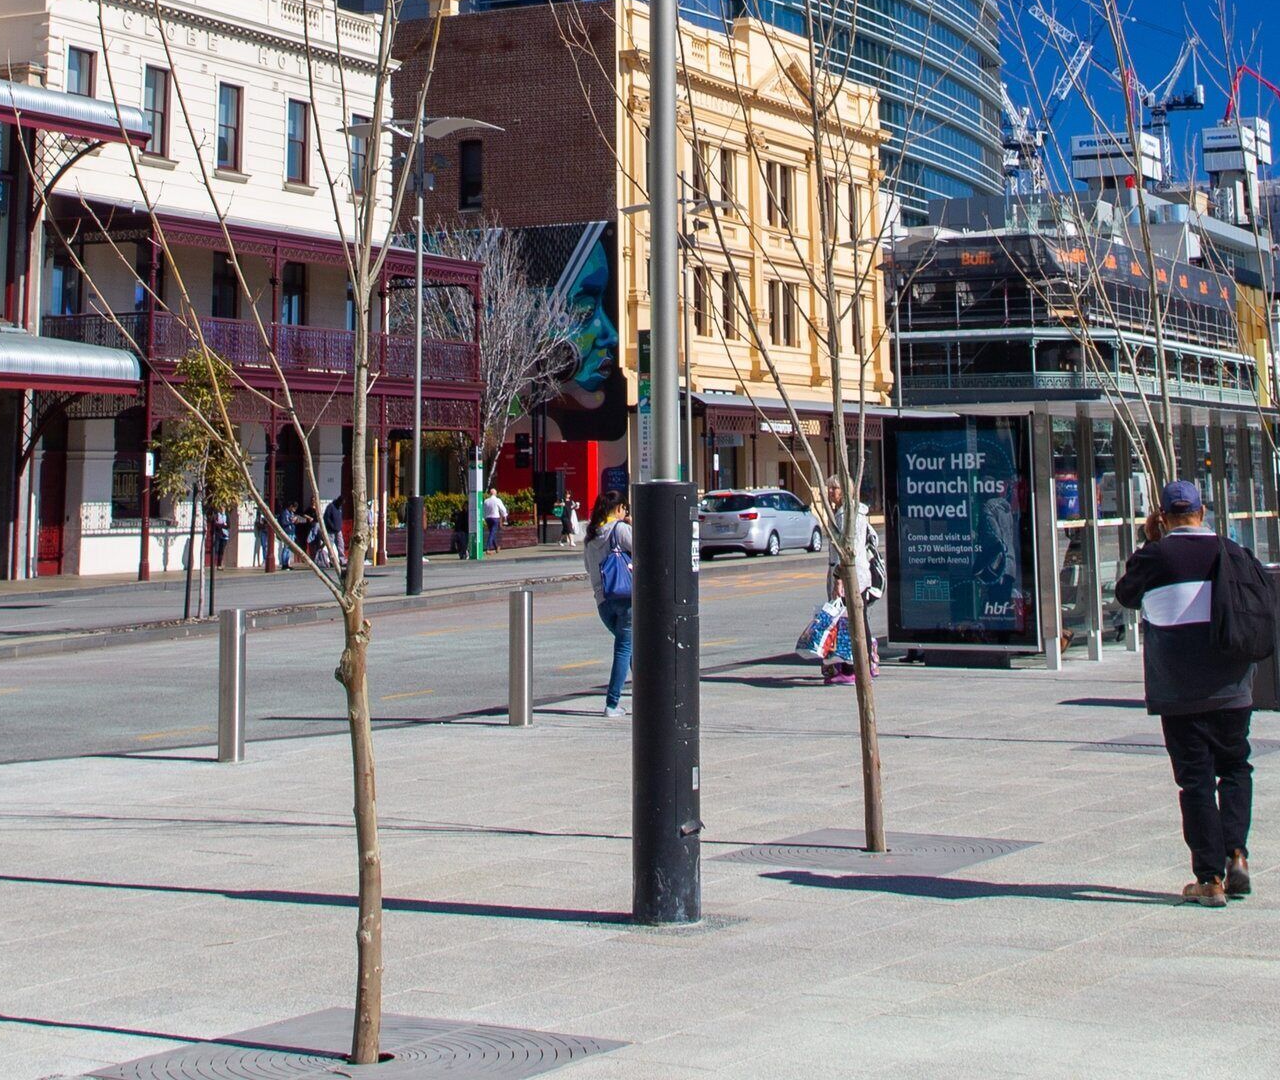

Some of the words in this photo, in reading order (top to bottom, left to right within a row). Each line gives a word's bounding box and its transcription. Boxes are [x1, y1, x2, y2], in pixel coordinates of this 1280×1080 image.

[123, 12, 219, 52] GLOBE
[258, 47, 342, 84] HOTEL
[906, 454, 945, 470] Your
[950, 452, 986, 470] HBF
[907, 476, 968, 494] branch
[973, 476, 1005, 494] has
[907, 500, 968, 518] moved
[908, 533, 928, 541] Come
[929, 533, 943, 541] and
[945, 533, 960, 541] visit
[918, 545, 932, 553] 570
[933, 545, 972, 555] Wellington
[908, 556, 926, 565] (near
[927, 556, 946, 565] Perth
[947, 556, 970, 565] Arena)
[984, 601, 1009, 615] hbf
